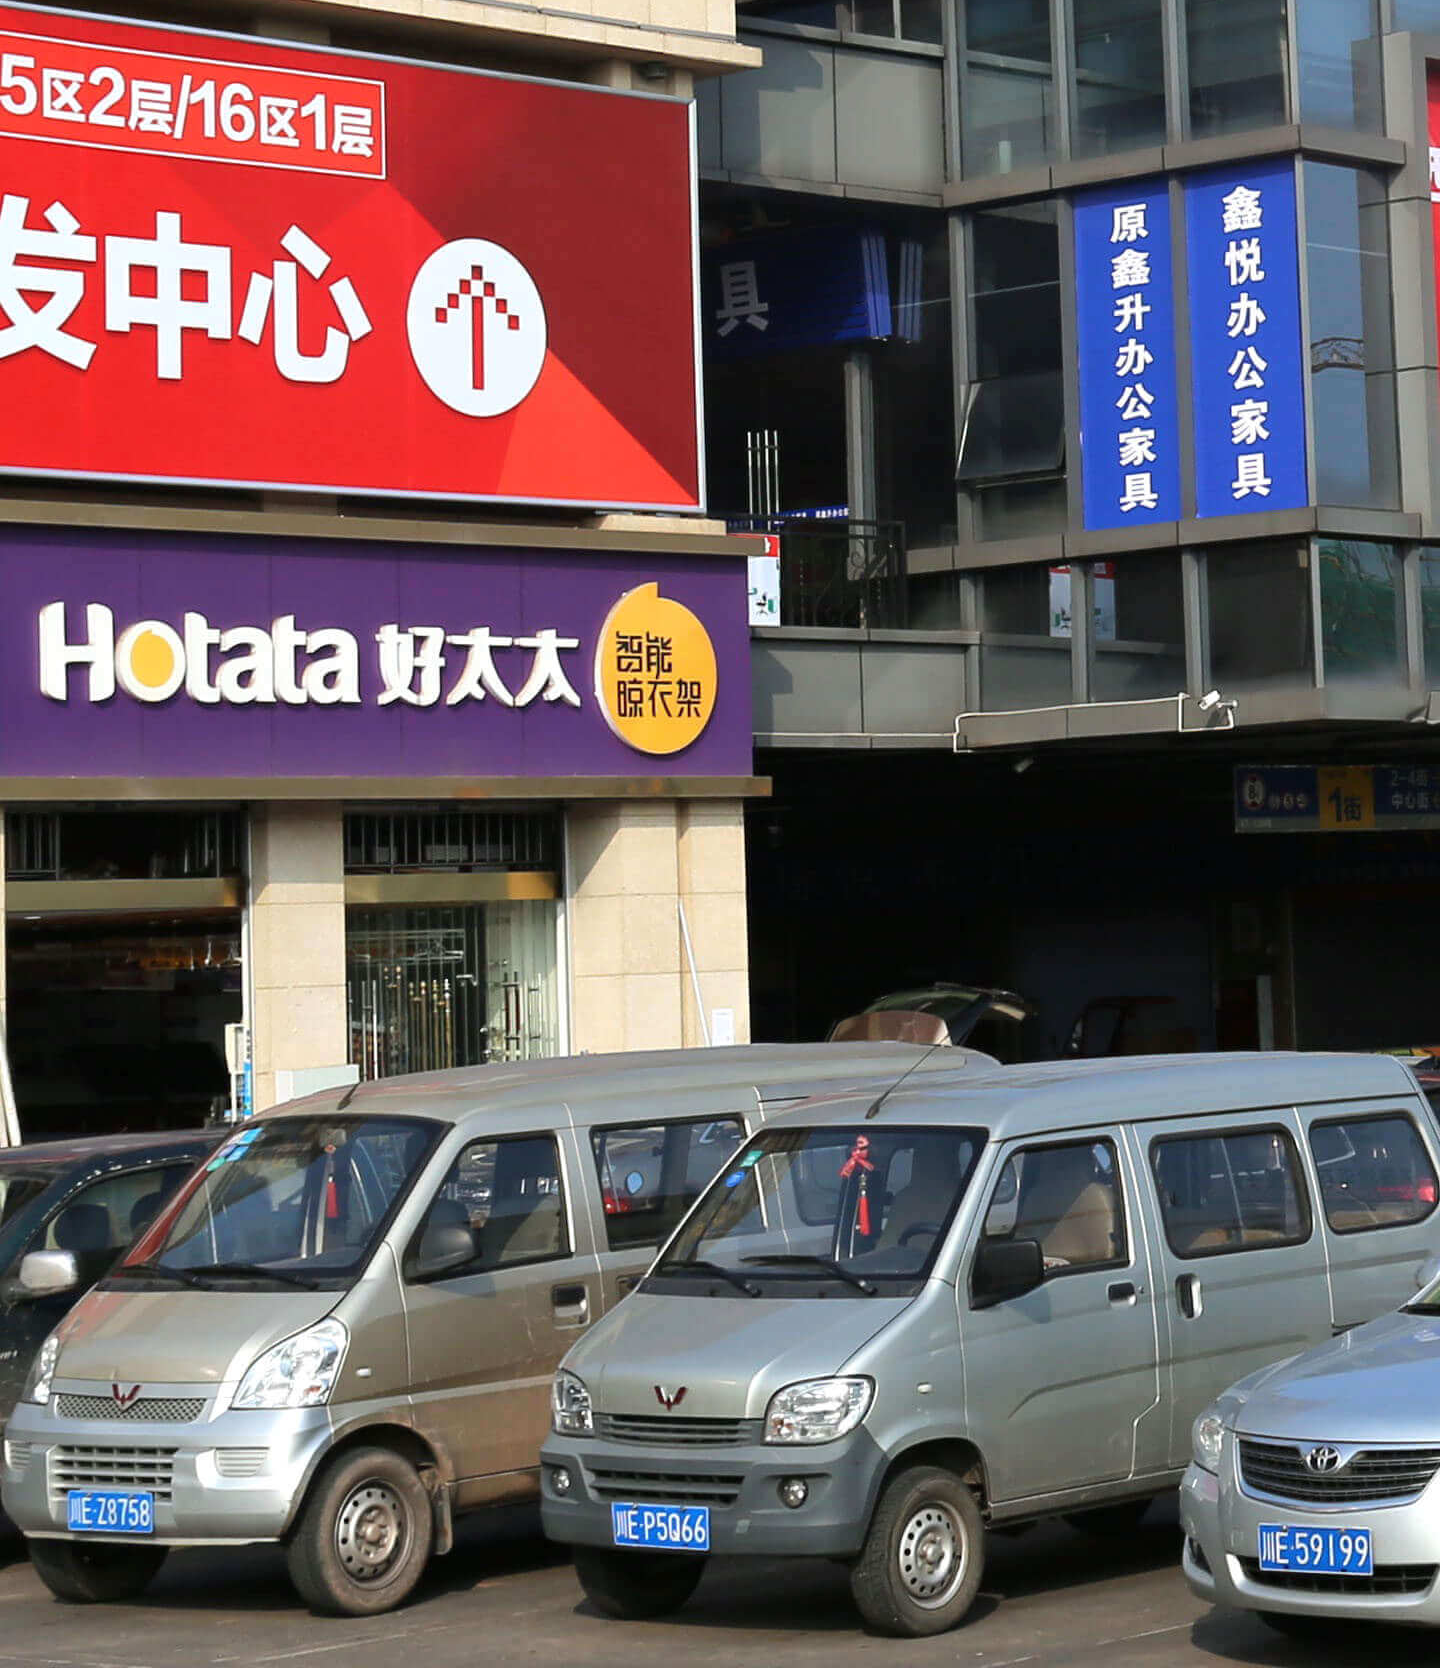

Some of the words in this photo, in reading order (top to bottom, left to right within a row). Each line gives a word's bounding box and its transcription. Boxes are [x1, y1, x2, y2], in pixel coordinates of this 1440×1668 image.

[1110, 204, 1157, 513] 原鑫升办公家具
[1222, 185, 1271, 499] 鑫悦办公家具
[38, 601, 362, 705] Hotata
[377, 622, 582, 708] 好太太
[615, 630, 673, 676] 智能
[615, 678, 702, 719] 晾衣架
